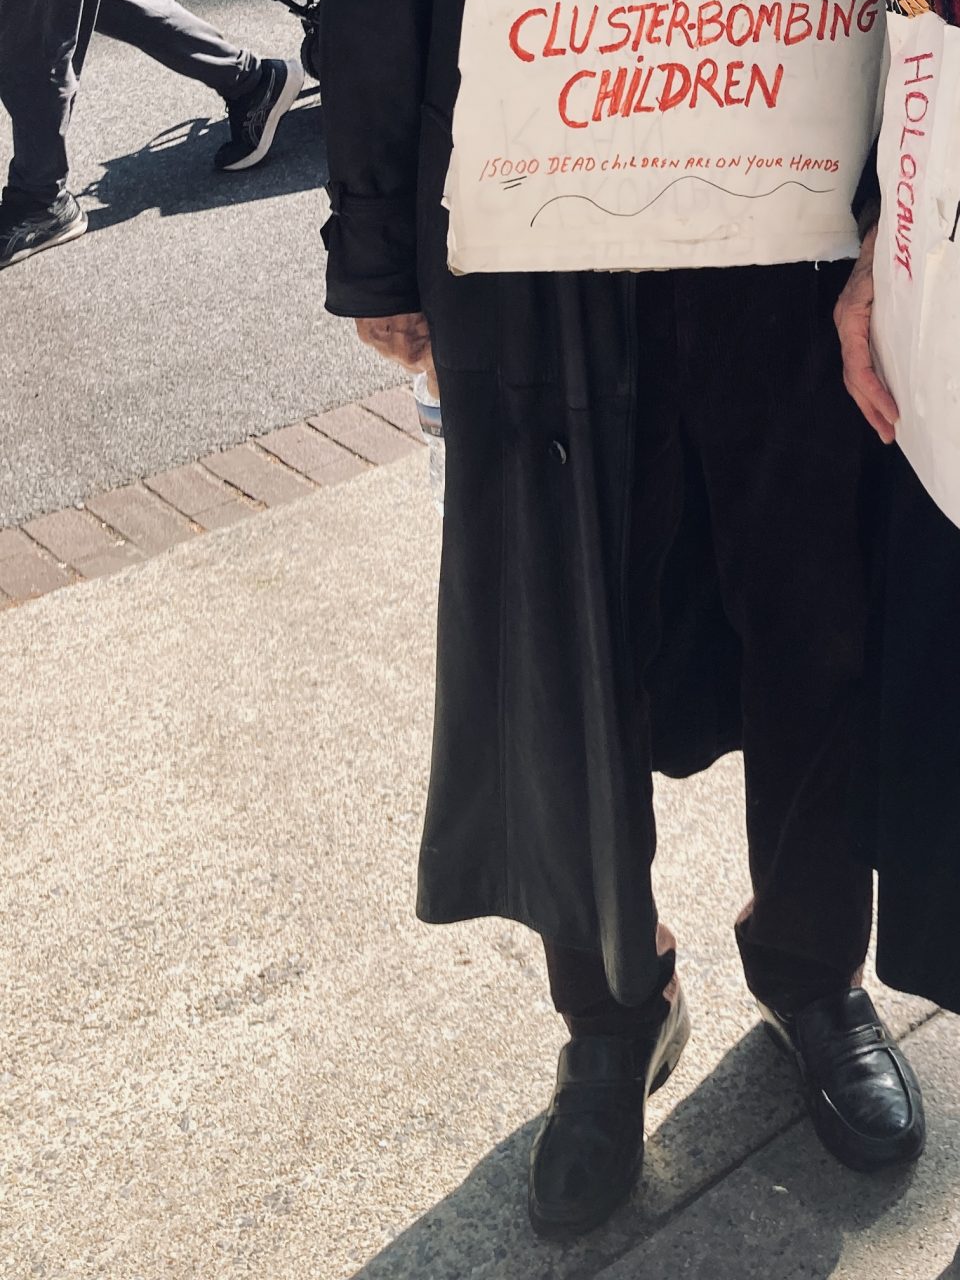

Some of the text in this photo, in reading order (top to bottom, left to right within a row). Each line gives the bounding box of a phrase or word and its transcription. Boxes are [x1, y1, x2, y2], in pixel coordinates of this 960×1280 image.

[558, 55, 784, 129] CHILDREN
[479, 157, 539, 182] 15000
[545, 155, 596, 175] DEAD
[685, 157, 710, 169] ARE
[716, 156, 741, 168] ON
[745, 155, 783, 175] YOUR
[790, 154, 839, 173] HANDS
[893, 52, 934, 281] HOLOCAUST
